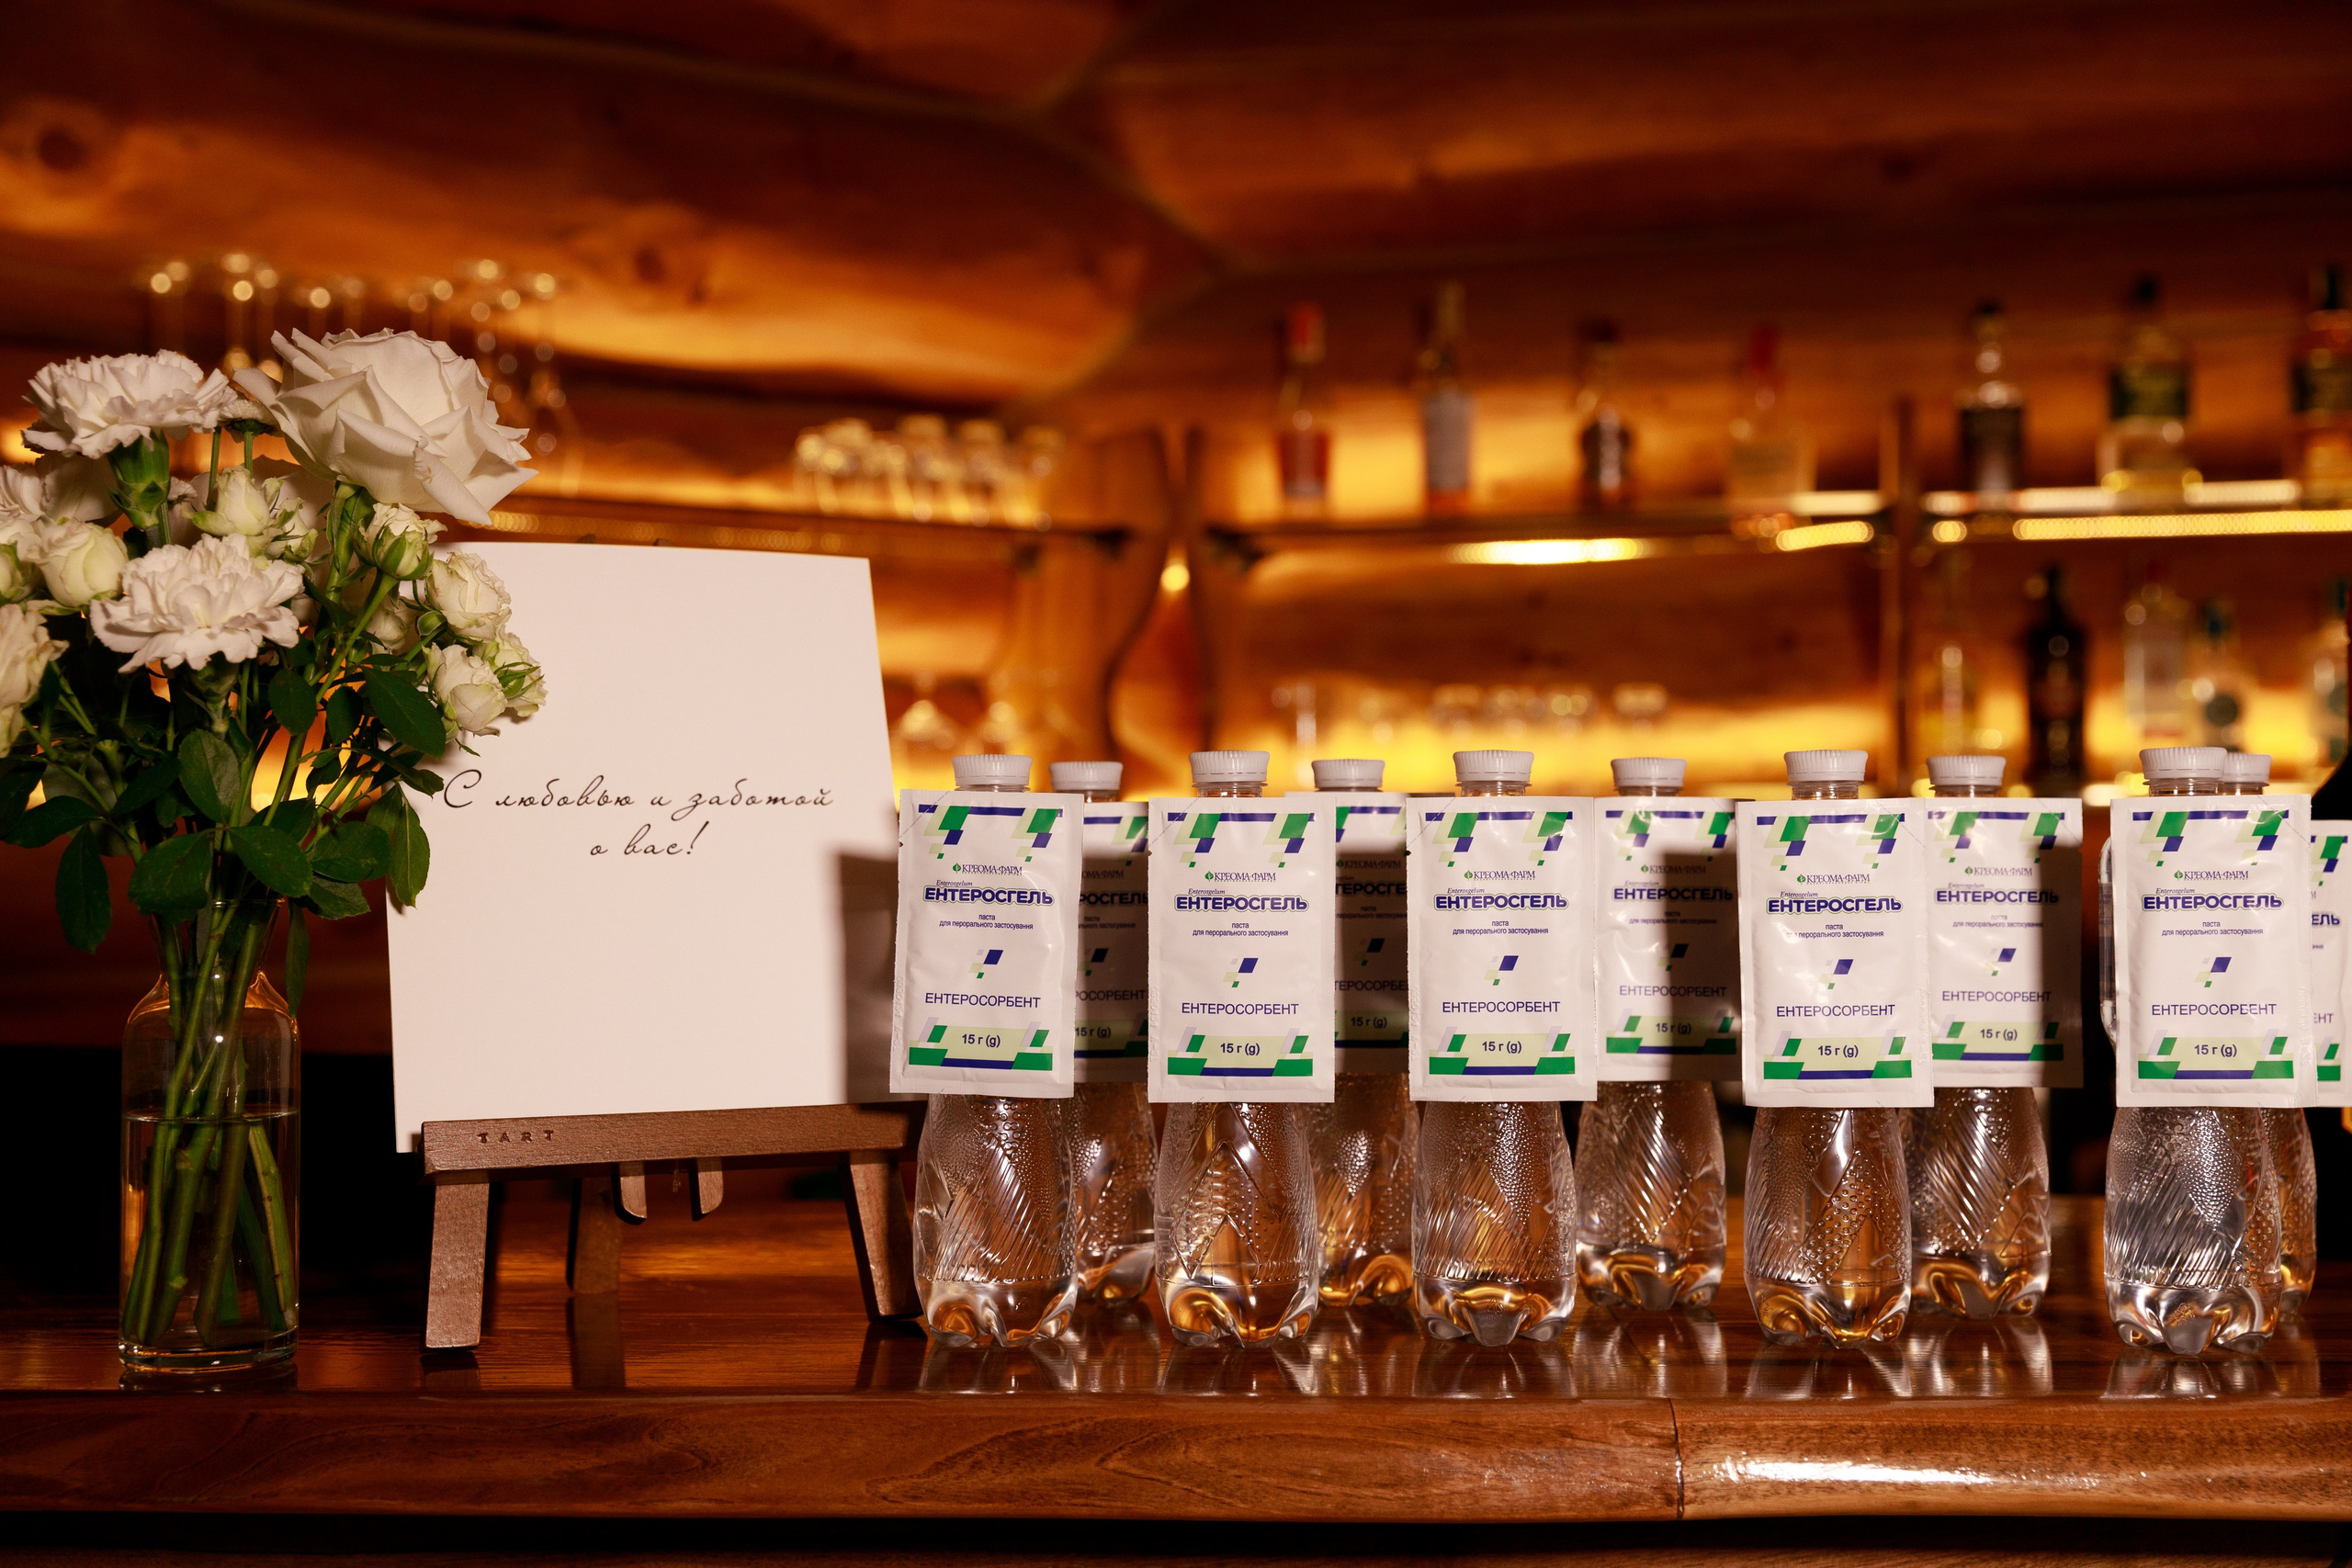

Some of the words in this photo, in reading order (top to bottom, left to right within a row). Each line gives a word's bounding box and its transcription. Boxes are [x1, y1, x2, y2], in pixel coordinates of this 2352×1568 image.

[444, 769, 481, 808] С
[495, 774, 635, 807] любовью
[650, 795, 672, 807] и
[671, 778, 833, 821] заботой
[590, 842, 608, 856] о
[624, 821, 710, 856] вас!
[924, 887, 1054, 905] ЕНТЕРОСГЕЛЬ
[1614, 888, 1733, 900] ЕНТЕРОСГЕЛЬ
[1937, 891, 2060, 903] ЕНТЕРОСГЕЛЬ
[1176, 897, 1307, 910] ЕНТЕРОСГЕЛЬ
[1436, 896, 1567, 909] ЕНТЕРОСГЕЛЬ
[1768, 898, 1902, 912] ЕНТЕРОСГЕЛЬ
[2143, 896, 2282, 909] ЕНТЕРОСГЕЛЬ
[952, 920, 993, 929] перорального
[1619, 985, 1727, 998] ЕНТЕРОСОРБЕНТ
[1942, 990, 2052, 1003] ЕНТЕРОСОРБЕНТ
[925, 992, 1041, 1009] ЕНТЕРОСОРБЕНТ
[1442, 1001, 1561, 1013] ЕНТЕРОСОРБЕНТ
[1182, 1002, 1299, 1015] ЕНТЕРОСОРБЕНТ
[1776, 1004, 1895, 1018] ЕНТЕРОСОРБЕНТ
[2151, 1003, 2277, 1016] ЕНТЕРОСОРБЕНТ
[1351, 1017, 1363, 1026] 15
[1374, 1016, 1387, 1028] (g)
[1656, 1023, 1668, 1032] 15
[1678, 1023, 1691, 1035] (g)
[1980, 1029, 1992, 1039] 15
[1996, 1031, 2000, 1039] г
[2003, 1029, 2018, 1041] (g)
[962, 1033, 975, 1044] 15
[978, 1036, 983, 1044] г
[985, 1034, 1001, 1047] (g)
[1220, 1043, 1233, 1053] 15
[1237, 1045, 1242, 1054] г
[1244, 1043, 1260, 1055] (g)
[1482, 1041, 1495, 1052] 15
[1498, 1043, 1504, 1052] г
[1506, 1041, 1522, 1055] (g)
[1817, 1045, 1832, 1055] 15
[1843, 1045, 1859, 1058] (g)
[2194, 1045, 2209, 1055] 15
[2212, 1046, 2217, 1055] г
[2221, 1044, 2237, 1057] (g)
